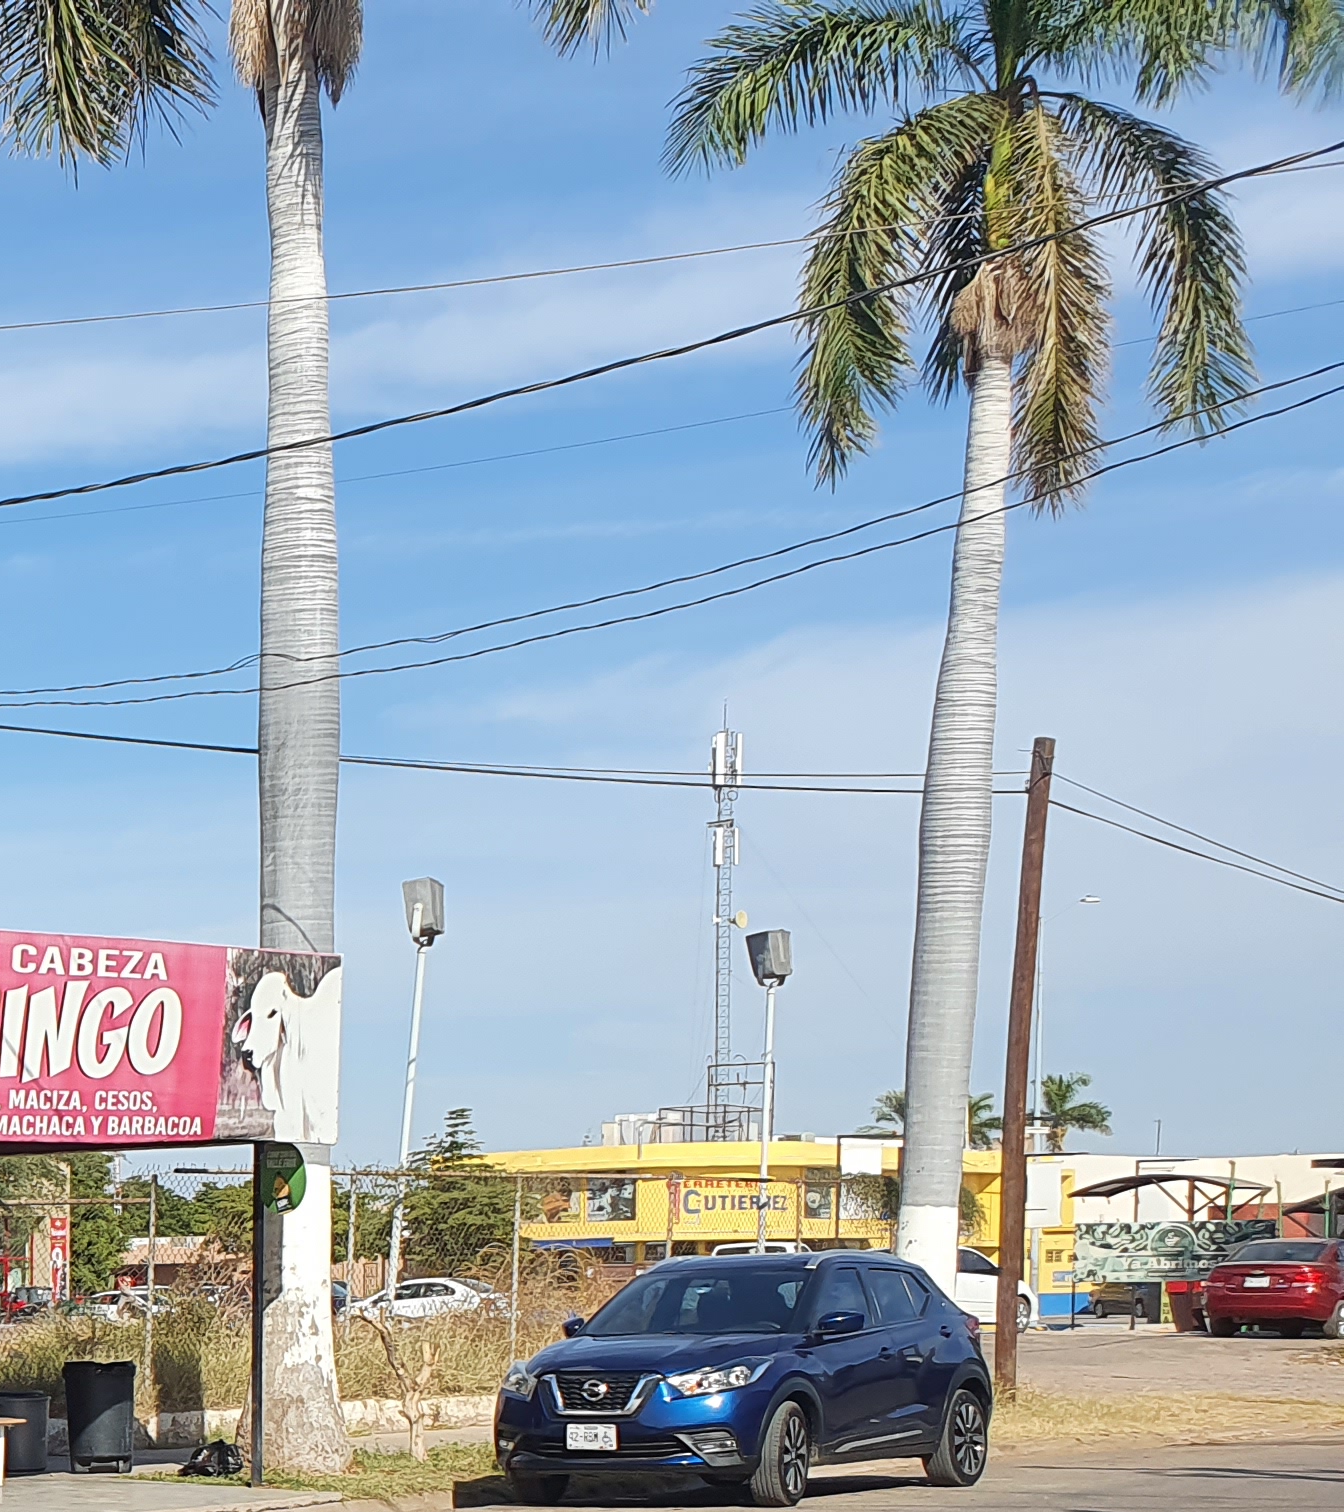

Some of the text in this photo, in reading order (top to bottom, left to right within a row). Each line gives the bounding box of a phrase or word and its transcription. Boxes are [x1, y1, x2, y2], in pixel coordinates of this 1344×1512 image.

[11, 943, 168, 980] CABEZA
[8, 1089, 87, 1113] MACIZA,
[94, 1090, 158, 1114] CESOS,
[91, 1115, 104, 1136] Y
[107, 1116, 202, 1136] BARBACOA
